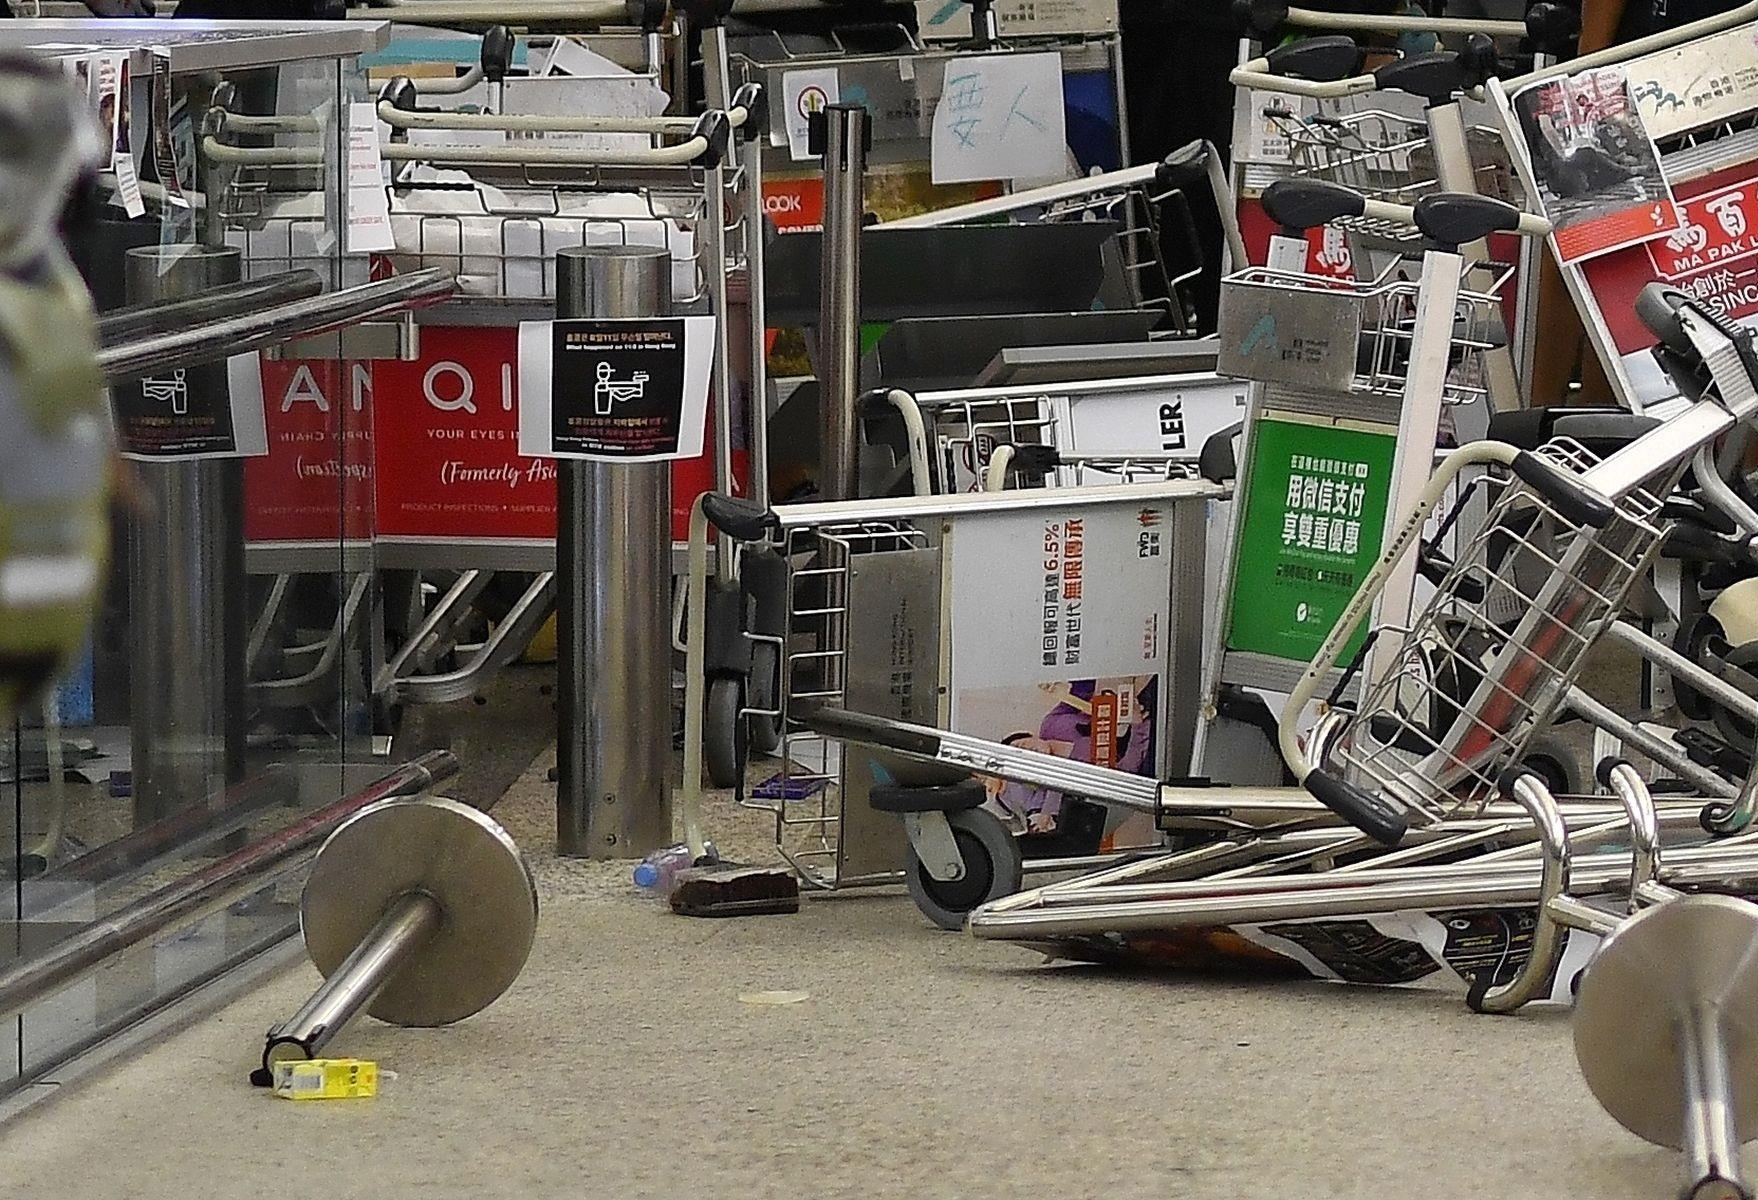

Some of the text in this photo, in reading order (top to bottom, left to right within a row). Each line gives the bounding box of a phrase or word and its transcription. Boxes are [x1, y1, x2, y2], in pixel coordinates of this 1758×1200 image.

[1673, 253, 1704, 272] MA
[1707, 240, 1746, 261] PAK
[426, 429, 465, 440] YOUR
[470, 430, 505, 441] EYES
[441, 459, 522, 489] (Formerly
[1286, 474, 1366, 518] 用微信支付
[1281, 510, 1361, 554] 享雙重優惠
